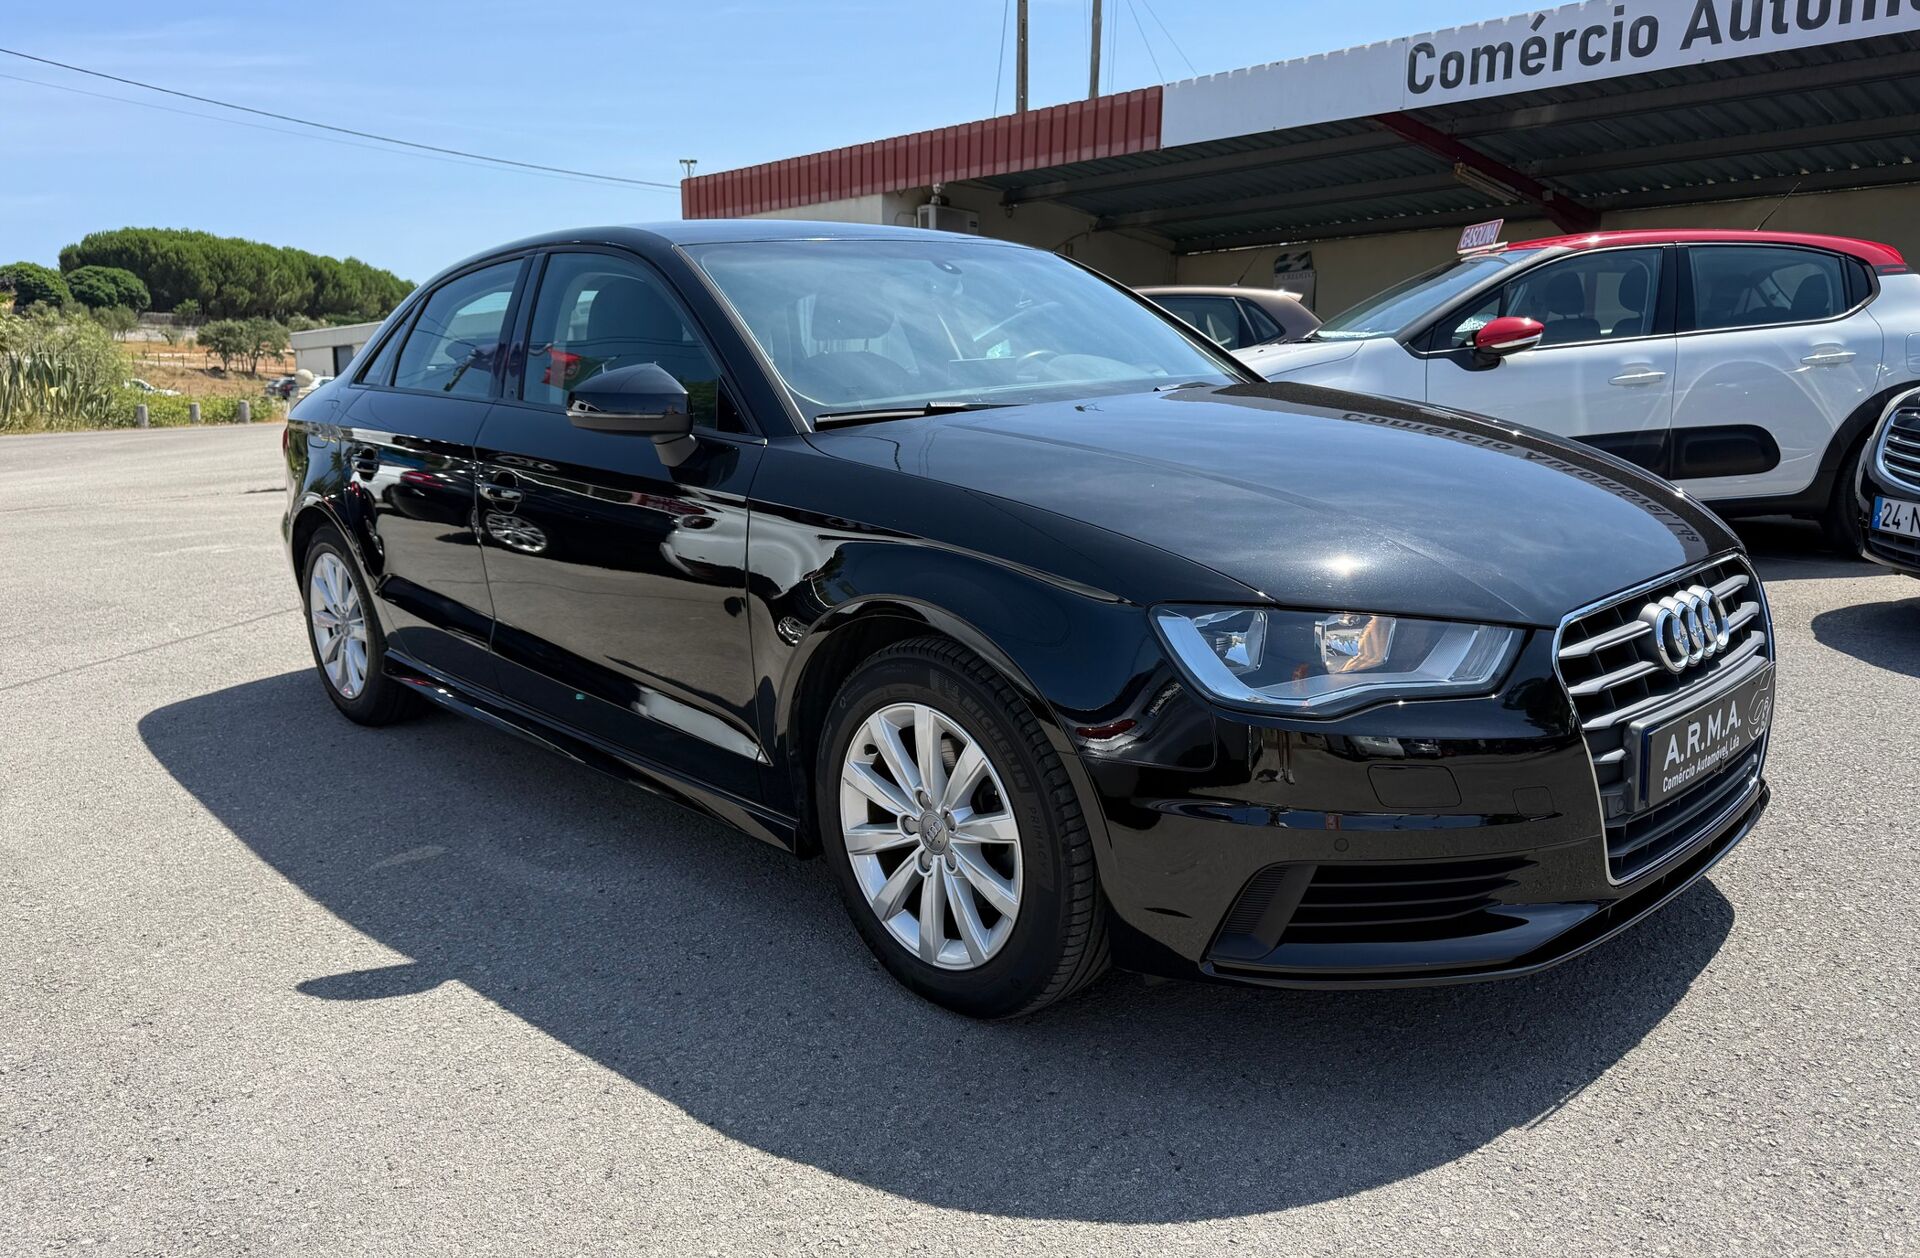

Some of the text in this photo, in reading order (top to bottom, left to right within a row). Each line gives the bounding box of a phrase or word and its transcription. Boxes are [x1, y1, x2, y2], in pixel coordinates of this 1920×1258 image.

[1405, 5, 1659, 94] Comércio
[1461, 223, 1498, 248] GASOLINA
[960, 694, 1032, 790] MICHELIN
[1663, 700, 1742, 771] A.R.M.A.
[1662, 763, 1695, 793] Comércio
